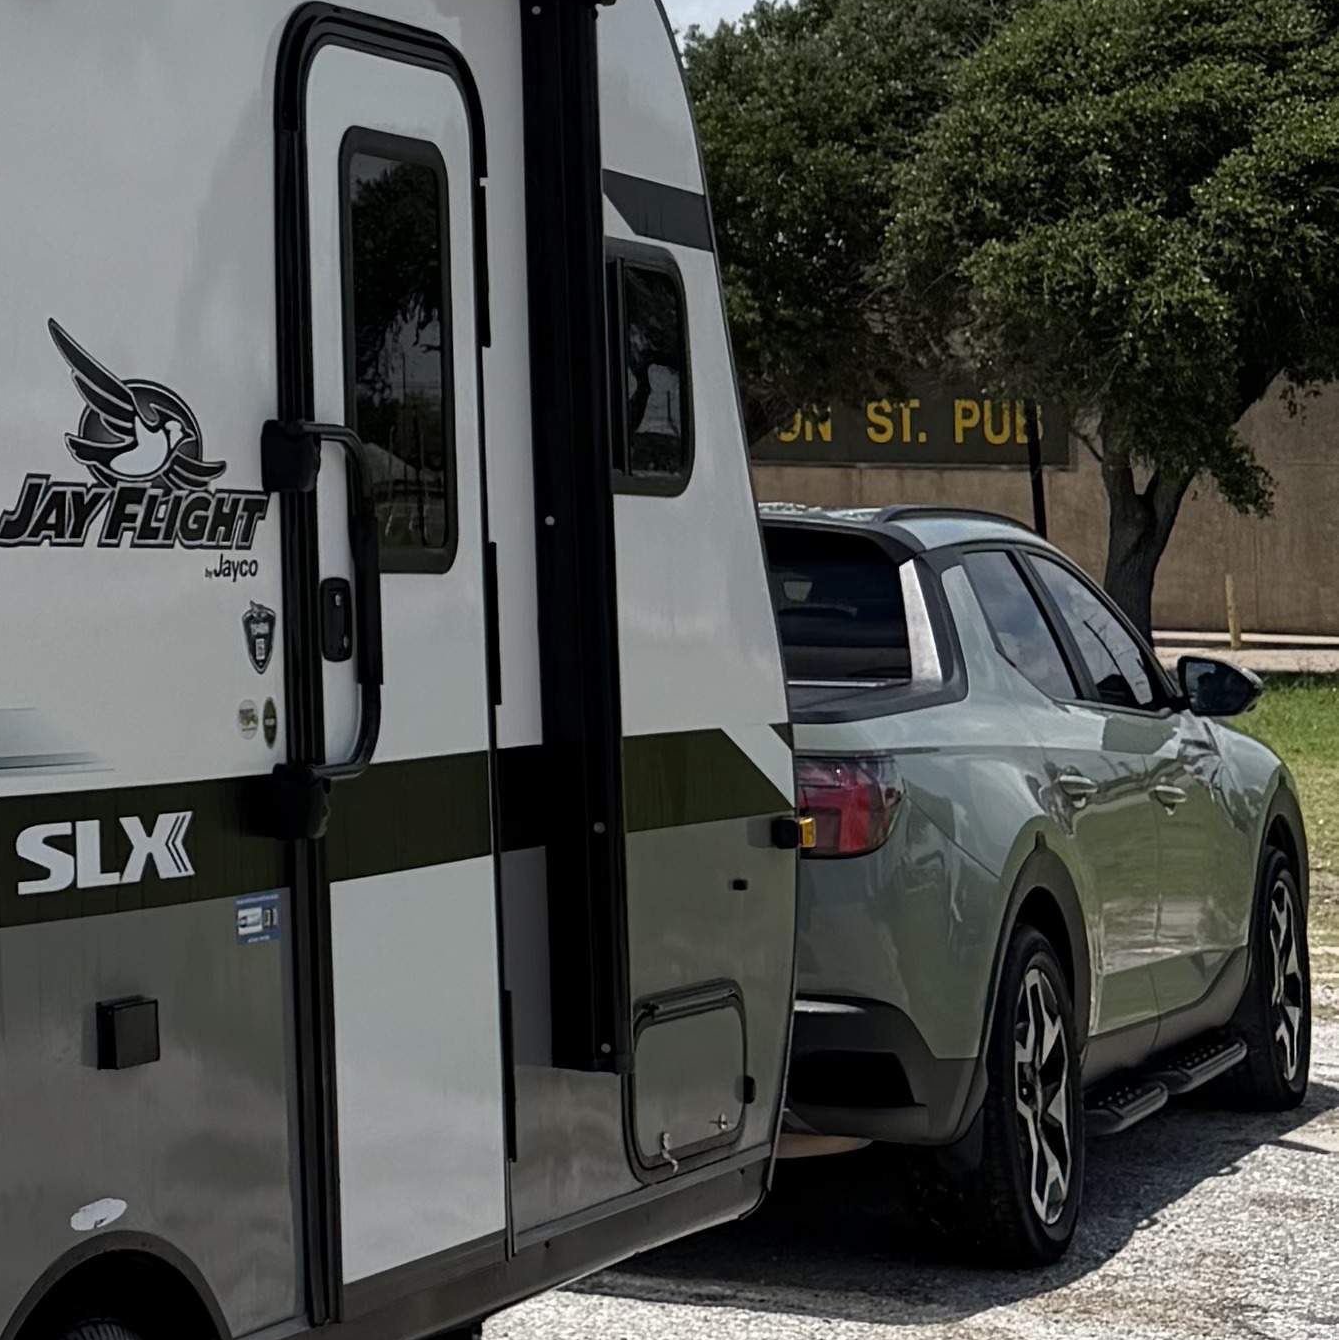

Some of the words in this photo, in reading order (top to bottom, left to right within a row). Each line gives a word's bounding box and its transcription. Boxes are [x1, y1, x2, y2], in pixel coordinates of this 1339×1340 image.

[866, 398, 927, 443] ST.
[954, 399, 1043, 445] PUB
[98, 481, 270, 550] FLIGHT
[214, 553, 259, 583] Jayco
[15, 810, 195, 895] SLX
